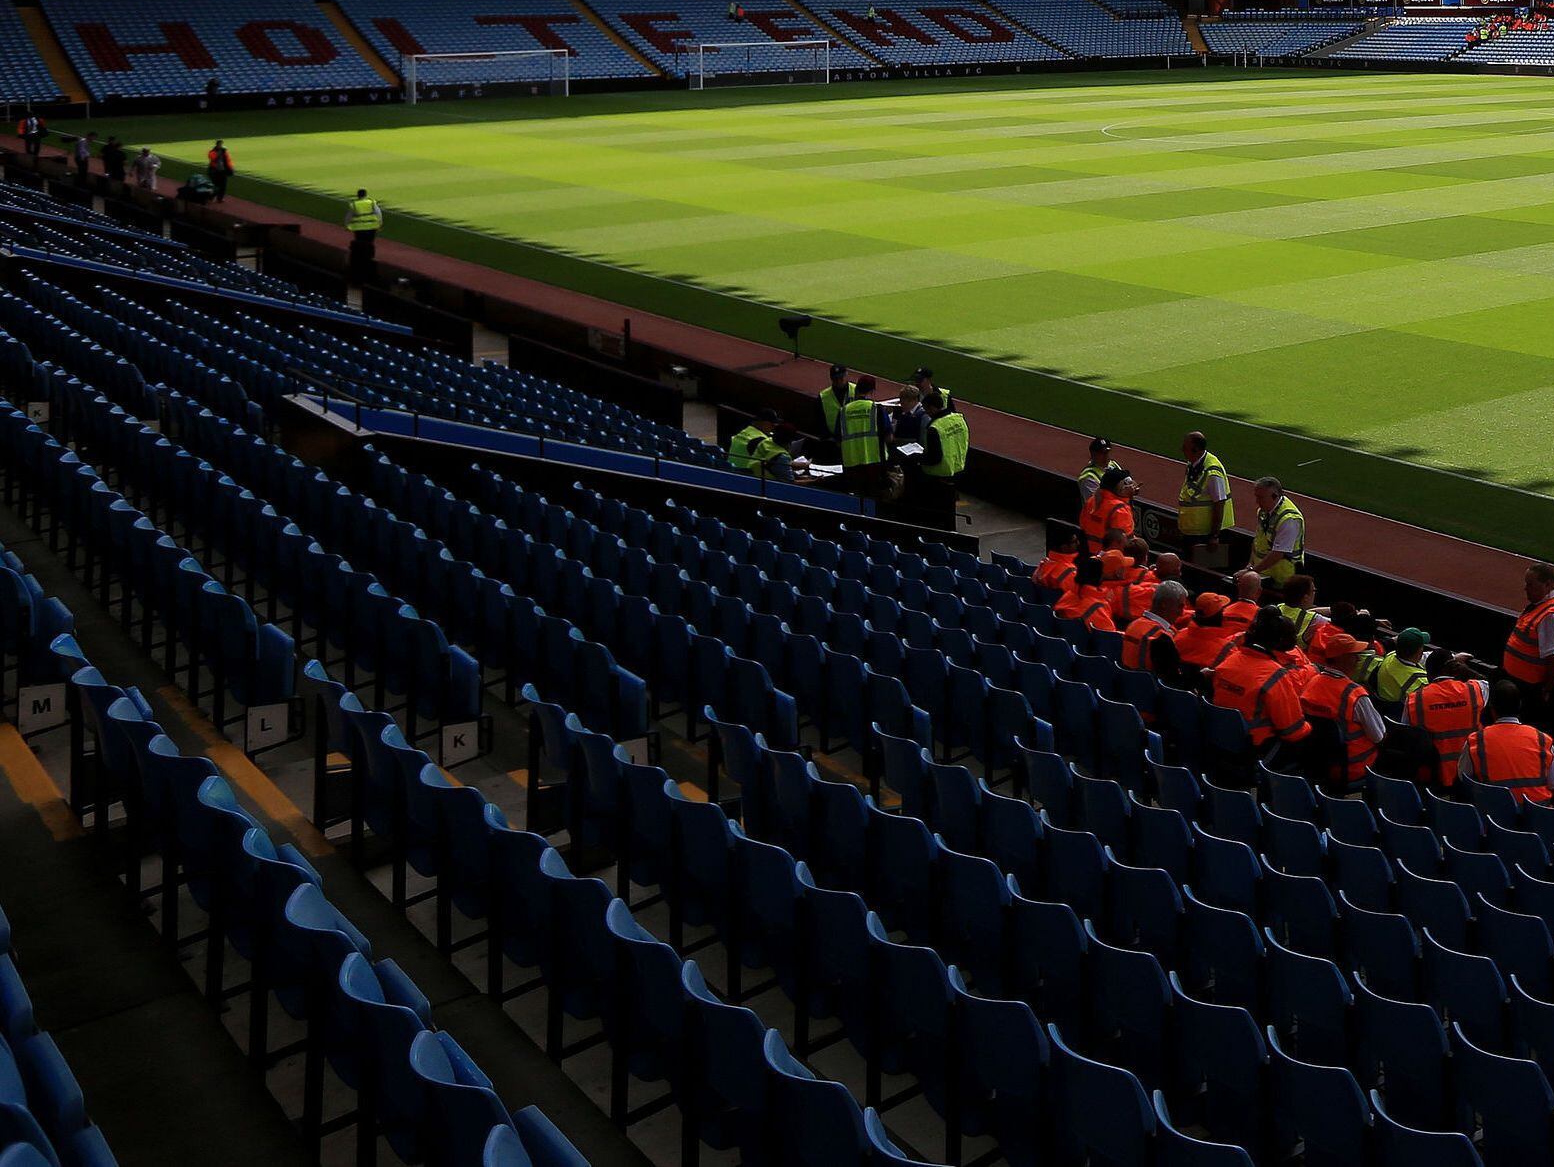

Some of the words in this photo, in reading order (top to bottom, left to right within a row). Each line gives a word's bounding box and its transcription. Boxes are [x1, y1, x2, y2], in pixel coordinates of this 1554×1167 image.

[831, 71, 889, 81] ASTON
[902, 68, 952, 77] VILLA
[964, 66, 981, 75] FC
[266, 93, 348, 106] ASTON
[458, 88, 481, 99] FC
[32, 697, 51, 714] M
[1428, 700, 1468, 711] STEWARD
[261, 718, 272, 732] L
[453, 734, 465, 748] K
